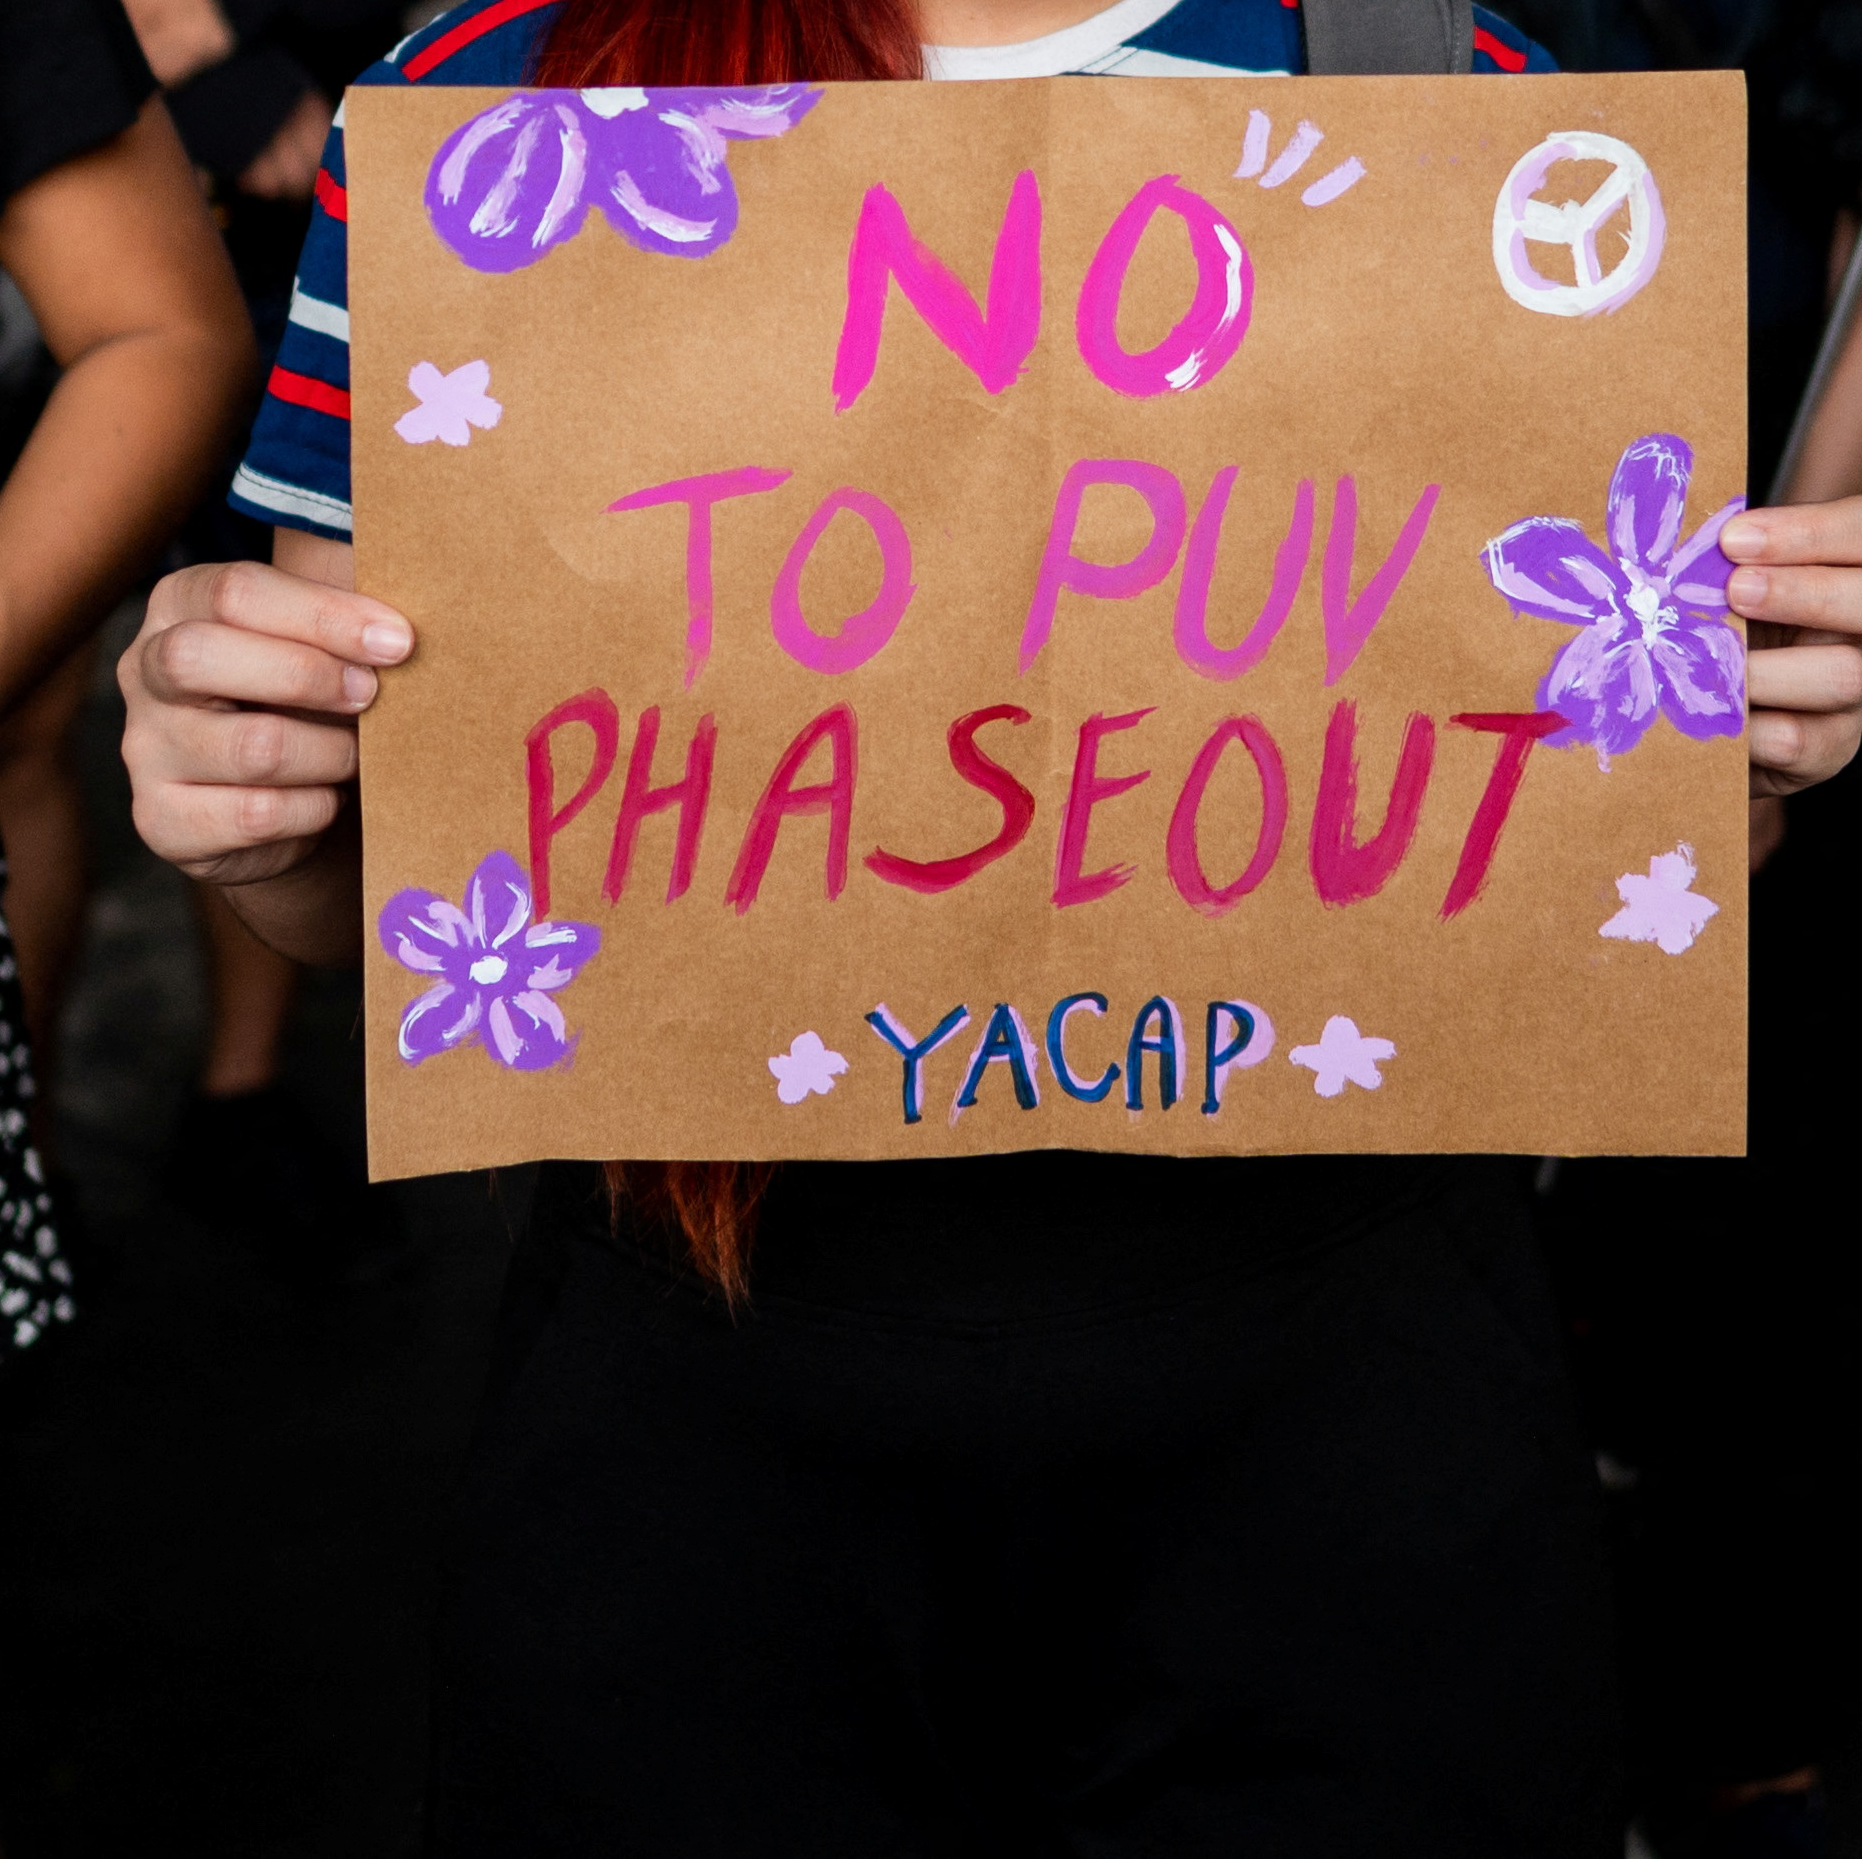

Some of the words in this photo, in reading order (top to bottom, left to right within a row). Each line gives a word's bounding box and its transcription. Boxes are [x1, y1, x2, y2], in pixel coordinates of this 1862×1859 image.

[832, 169, 1254, 416] NO
[605, 464, 918, 691] TO
[1018, 457, 1441, 689] PUV
[524, 687, 1572, 923] PHASEOUT
[864, 990, 1270, 1125] YACAP
